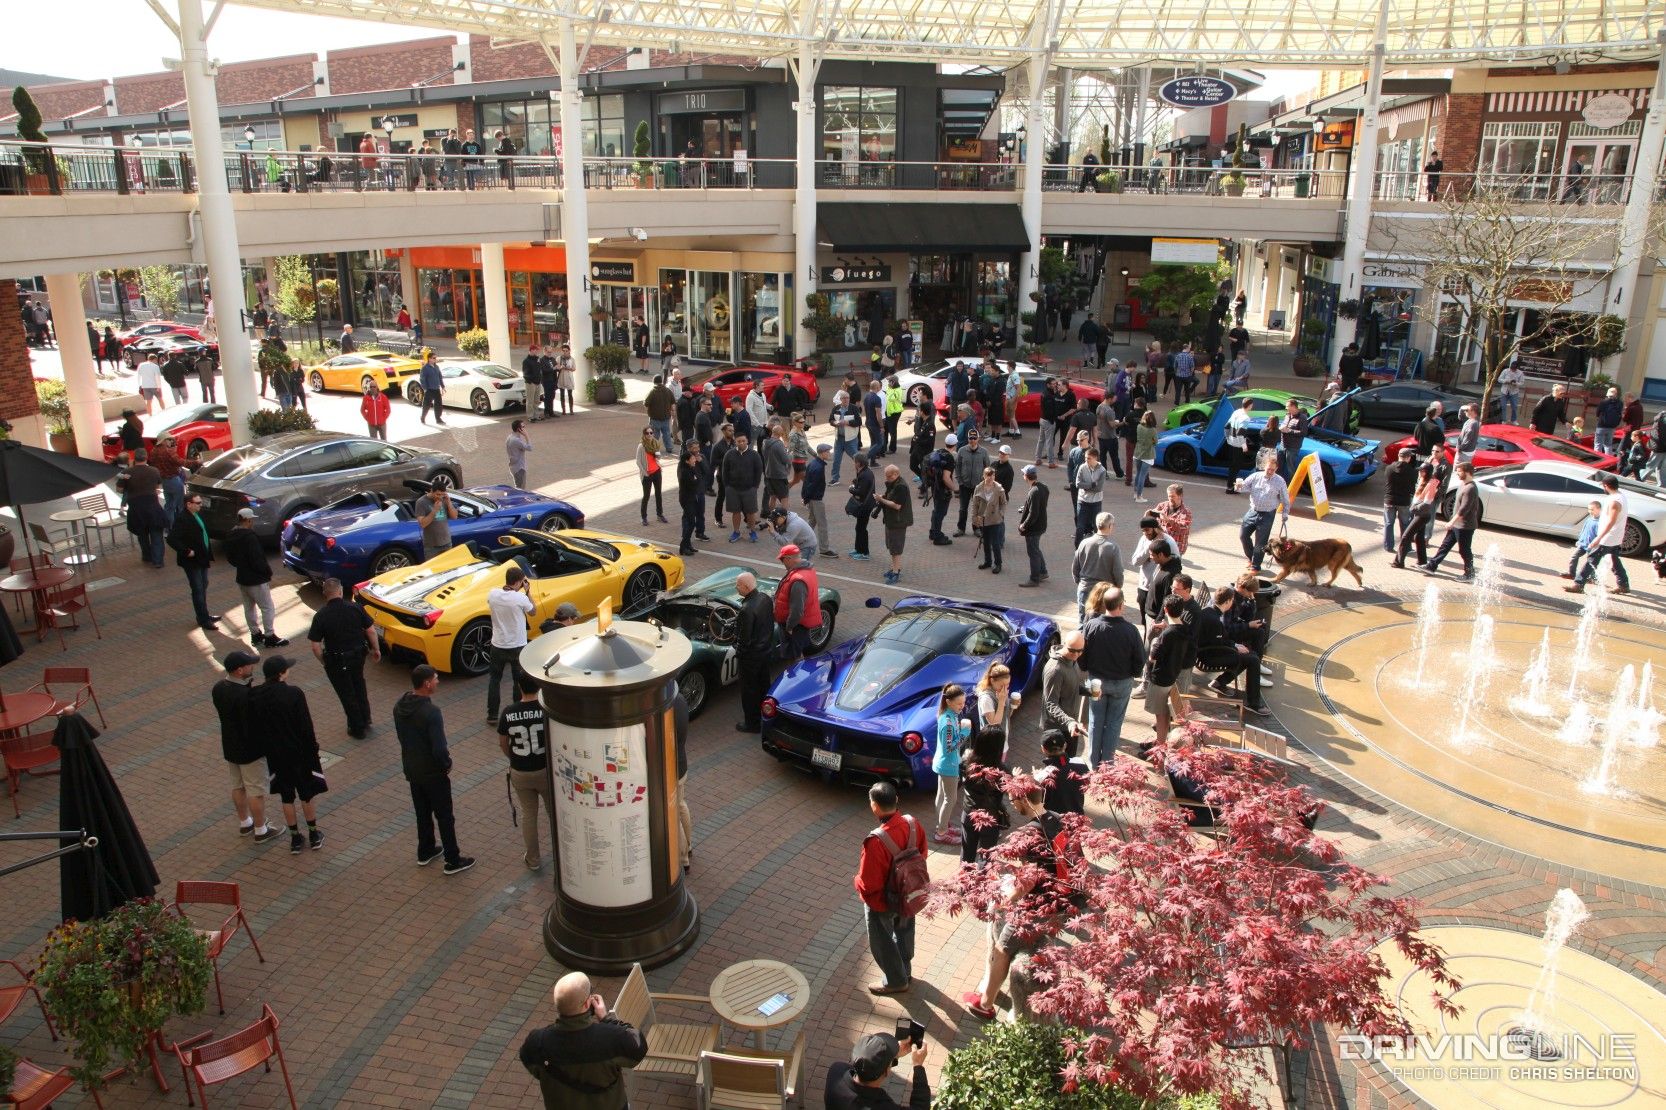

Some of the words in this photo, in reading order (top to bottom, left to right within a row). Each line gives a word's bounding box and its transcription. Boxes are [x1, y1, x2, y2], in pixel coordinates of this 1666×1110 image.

[685, 94, 706, 109] TRIO
[847, 270, 881, 279] fuego
[725, 655, 738, 681] 10
